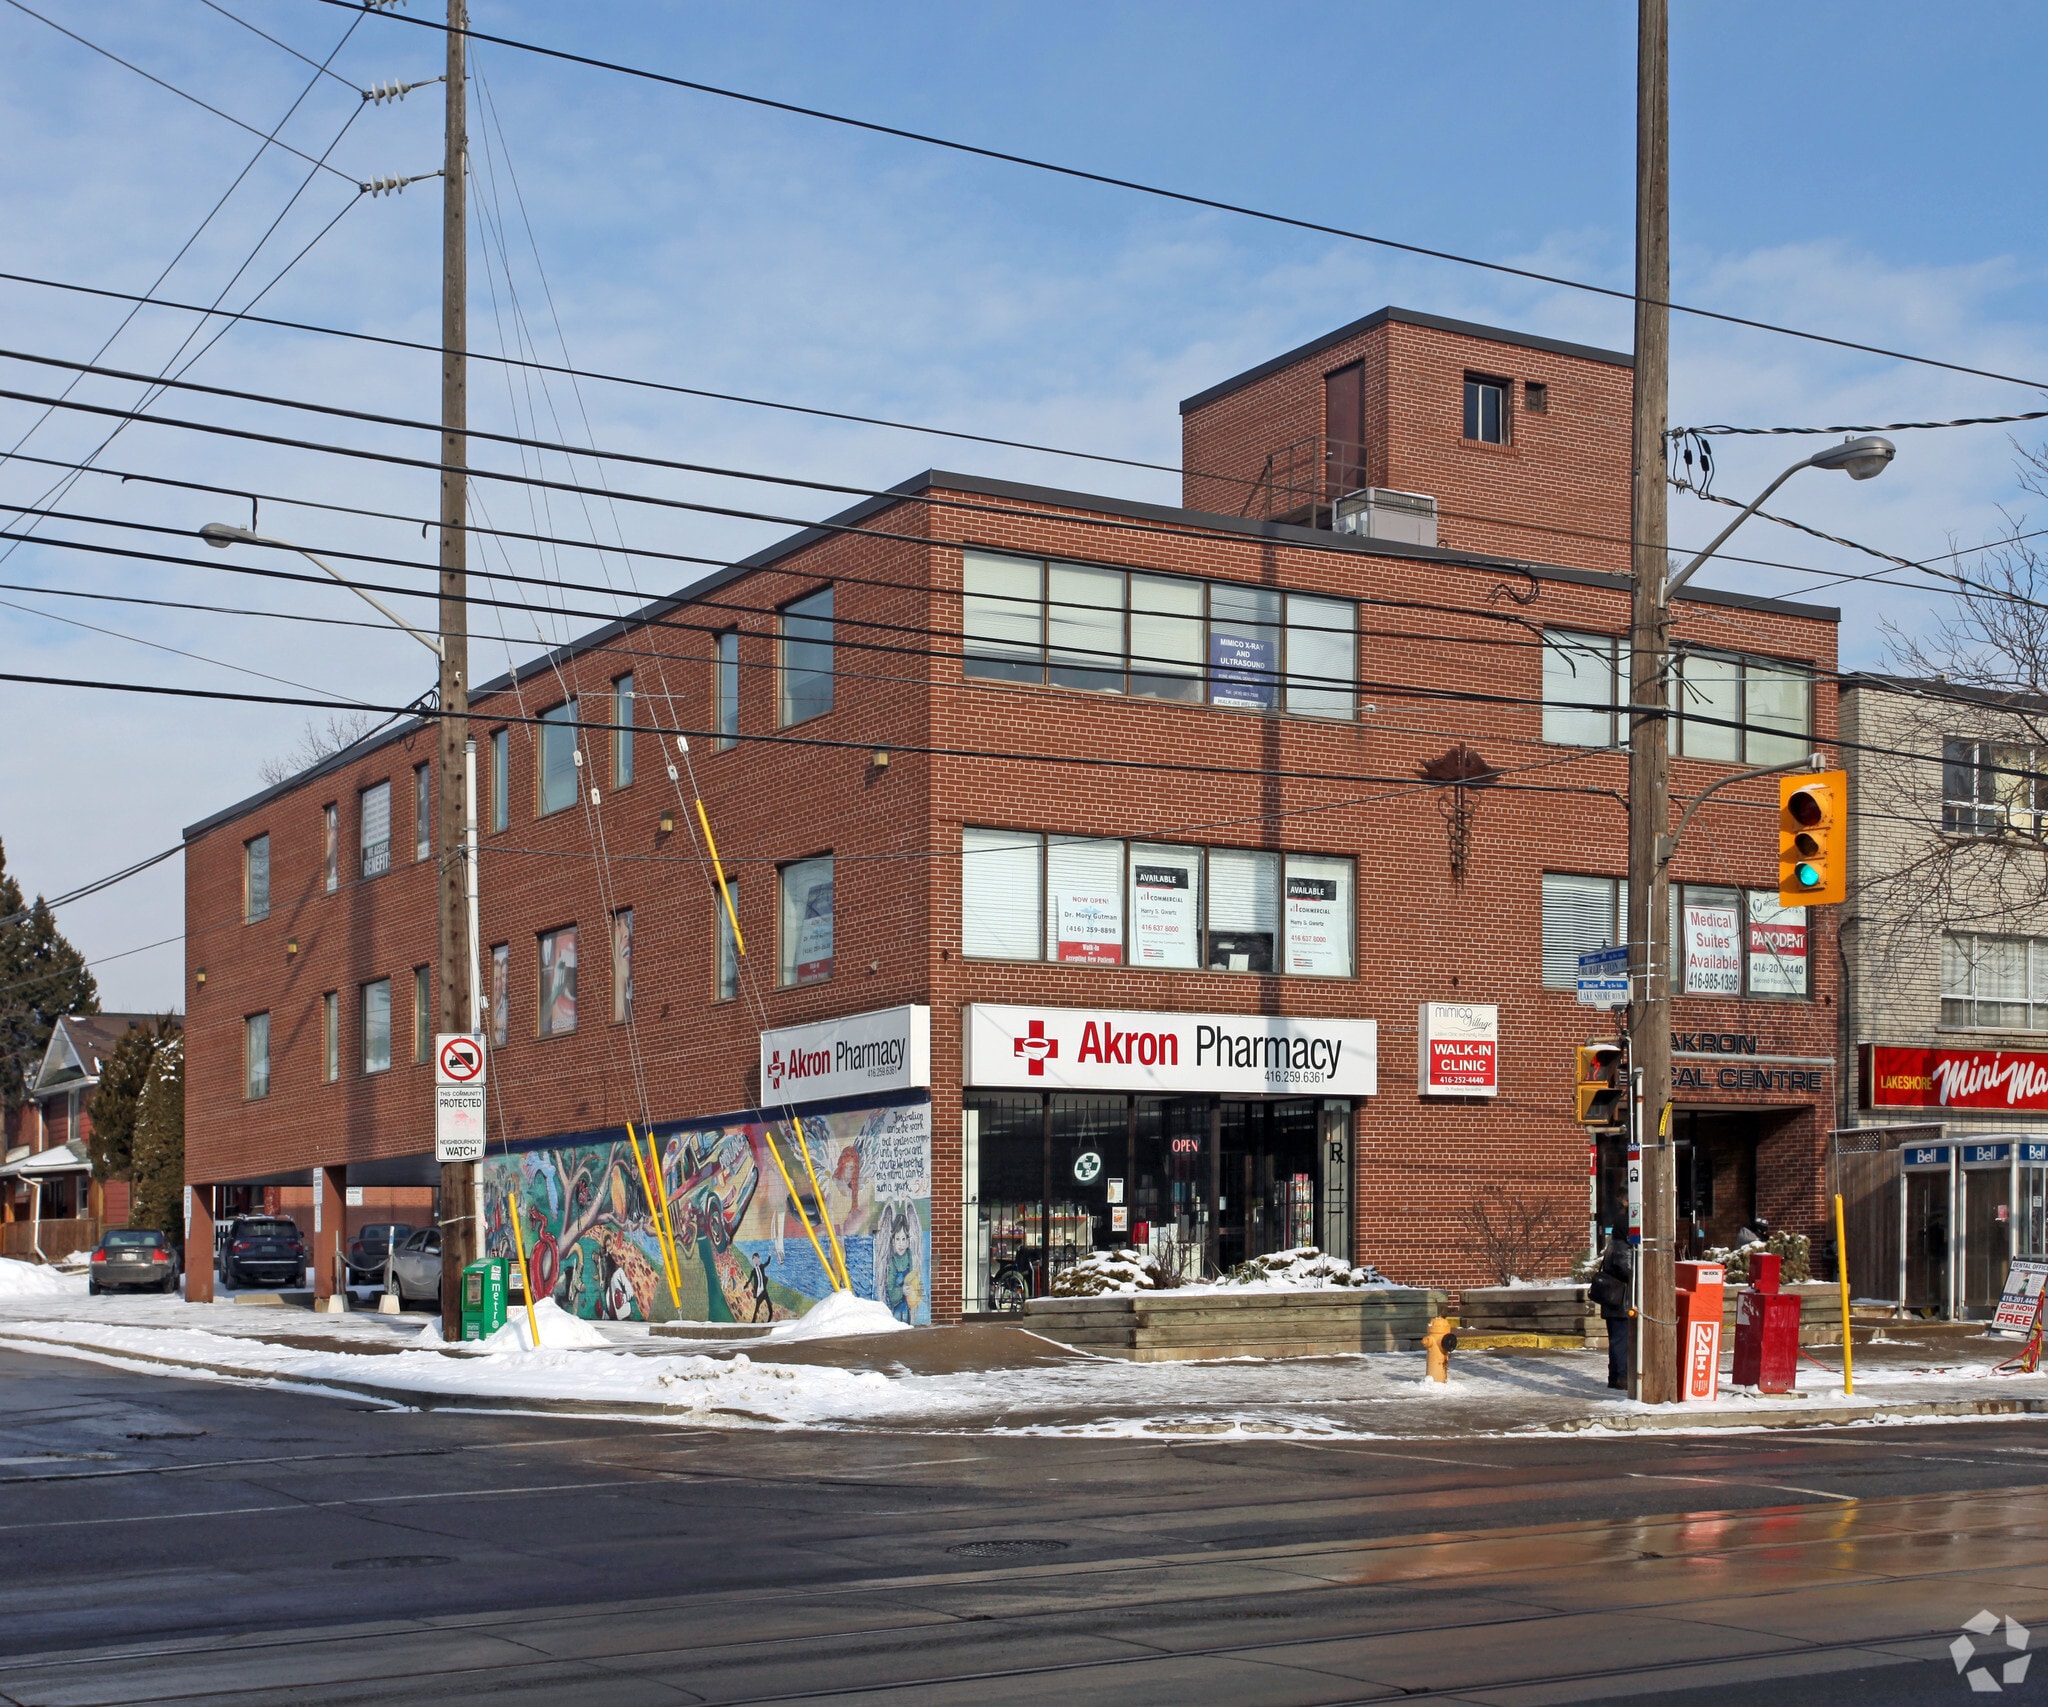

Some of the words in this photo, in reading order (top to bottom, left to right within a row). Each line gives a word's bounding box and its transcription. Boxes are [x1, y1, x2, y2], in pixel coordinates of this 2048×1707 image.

[1220, 638, 1244, 648] MIMICO
[1245, 642, 1264, 650] X-RAY
[1220, 657, 1265, 669] ULTRASOUND
[1140, 873, 1177, 884] AVAILABLE
[1290, 886, 1325, 896] AVAILABLE
[1150, 895, 1183, 903] COMMERCIAL
[1093, 912, 1117, 921] Gutman
[1299, 907, 1330, 915] COMMERCIAL
[1690, 911, 1732, 929] Medical
[1065, 925, 1085, 934] (416)
[1153, 924, 1163, 932] 637
[1164, 925, 1179, 933] 8000
[1696, 932, 1730, 949] Suites
[1689, 953, 1739, 970] Available
[1753, 963, 1804, 975] 416-2014440
[1688, 971, 1738, 991] 416-985-1396
[1580, 990, 1594, 1001] LAKE
[1594, 990, 1611, 1001] SHORE
[1435, 1007, 1473, 1019] mimico
[1462, 1013, 1494, 1032] Village
[1077, 1020, 1178, 1066] Akron
[1196, 1025, 1342, 1080] Pharmacy
[1433, 1043, 1492, 1056] WALK-IN
[787, 1048, 831, 1080] Akron
[835, 1037, 906, 1073] Pharmacy
[867, 1065, 898, 1078] 416.259.6361
[1440, 1059, 1487, 1072] CLINIC
[1264, 1071, 1325, 1084] 416.259.6361
[1439, 1076, 1485, 1085] 416-252-4440
[1719, 1068, 1822, 1091] CENTRE
[1880, 1075, 1933, 1090] LAKESHORE
[1932, 1051, 2001, 1106] Mini
[440, 1099, 481, 1108] PROTECTED
[910, 1120, 924, 1132] spark
[446, 1147, 477, 1156] WATCH
[1172, 1139, 1198, 1152] OPEN
[2029, 1145, 2046, 1159] Bell
[1917, 1149, 1937, 1163] Bell
[1976, 1146, 1997, 1160] Bell
[1995, 1322, 2029, 1330] consultation
[1996, 1313, 2032, 1326] FREE
